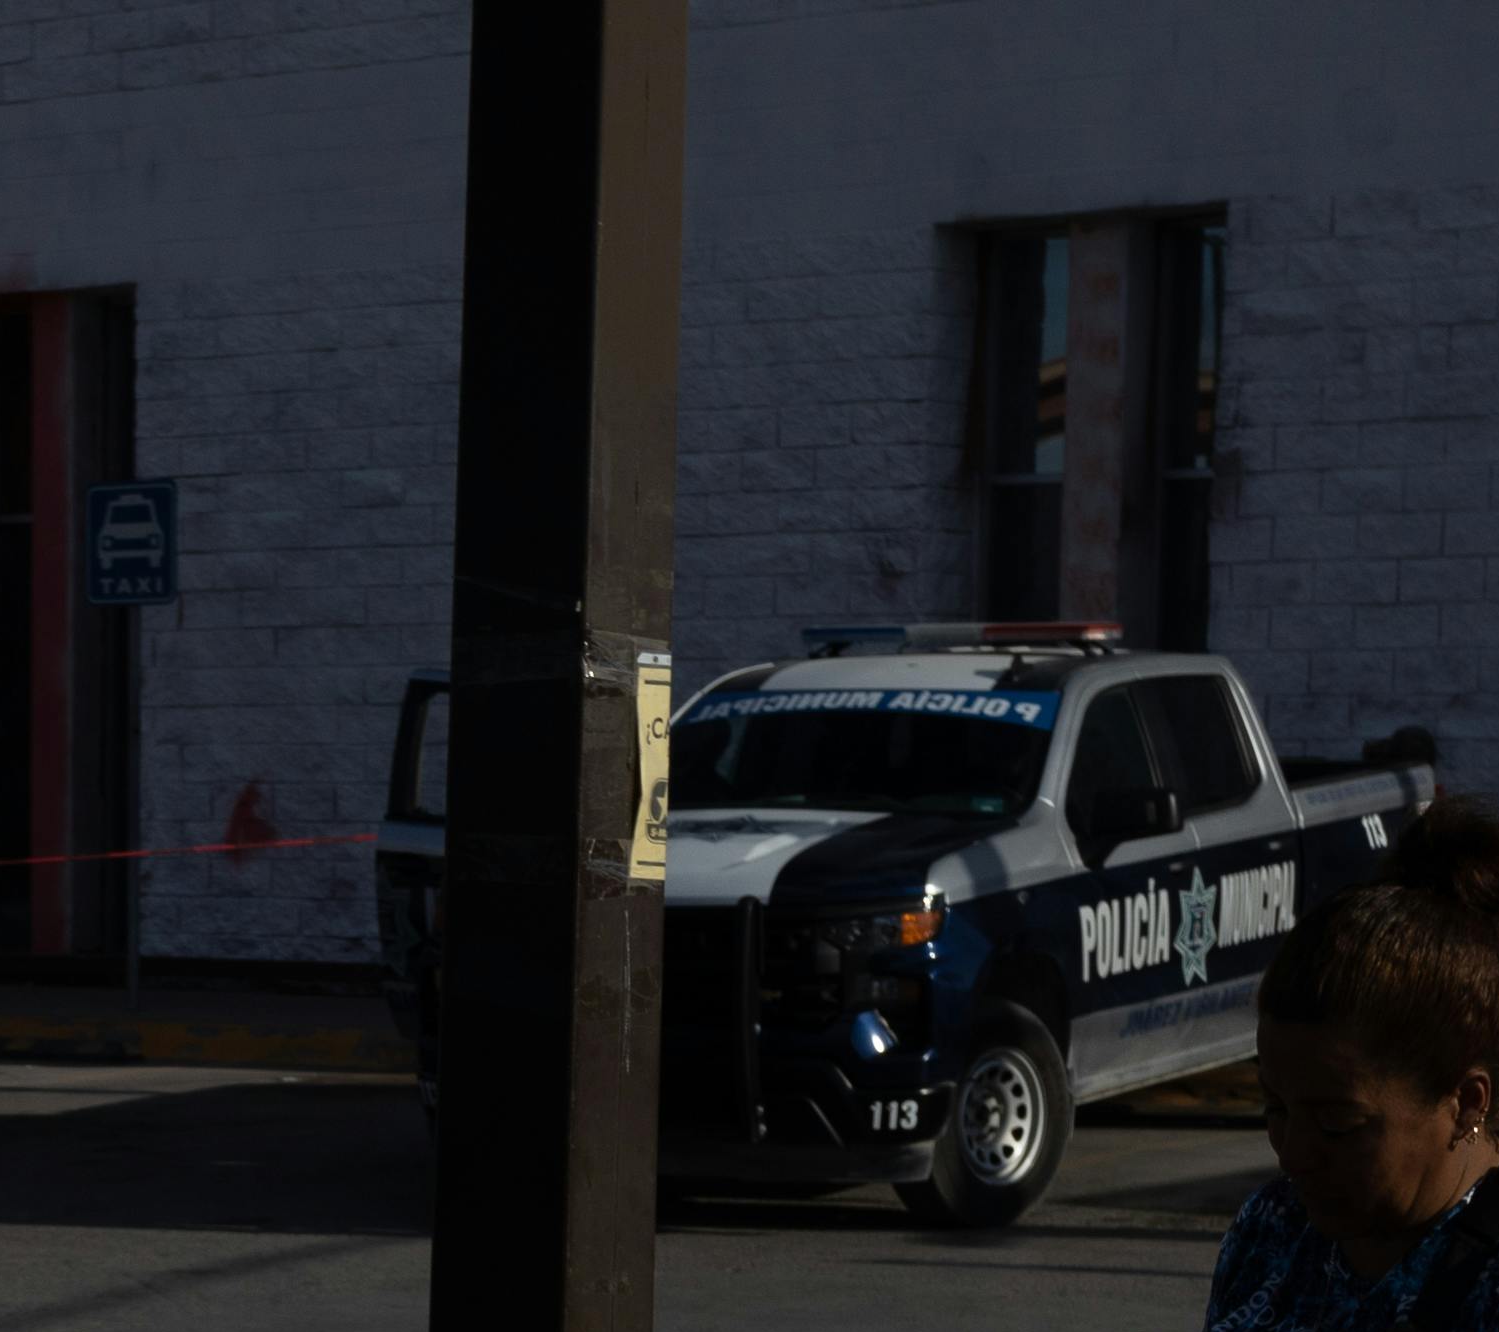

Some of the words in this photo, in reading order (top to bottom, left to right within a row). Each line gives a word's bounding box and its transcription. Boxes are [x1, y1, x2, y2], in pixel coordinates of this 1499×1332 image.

[99, 577, 164, 595] TAXI
[1078, 877, 1171, 984] POLICÍA
[1217, 859, 1296, 949] MUNICIPAL
[869, 1097, 919, 1132] 113
